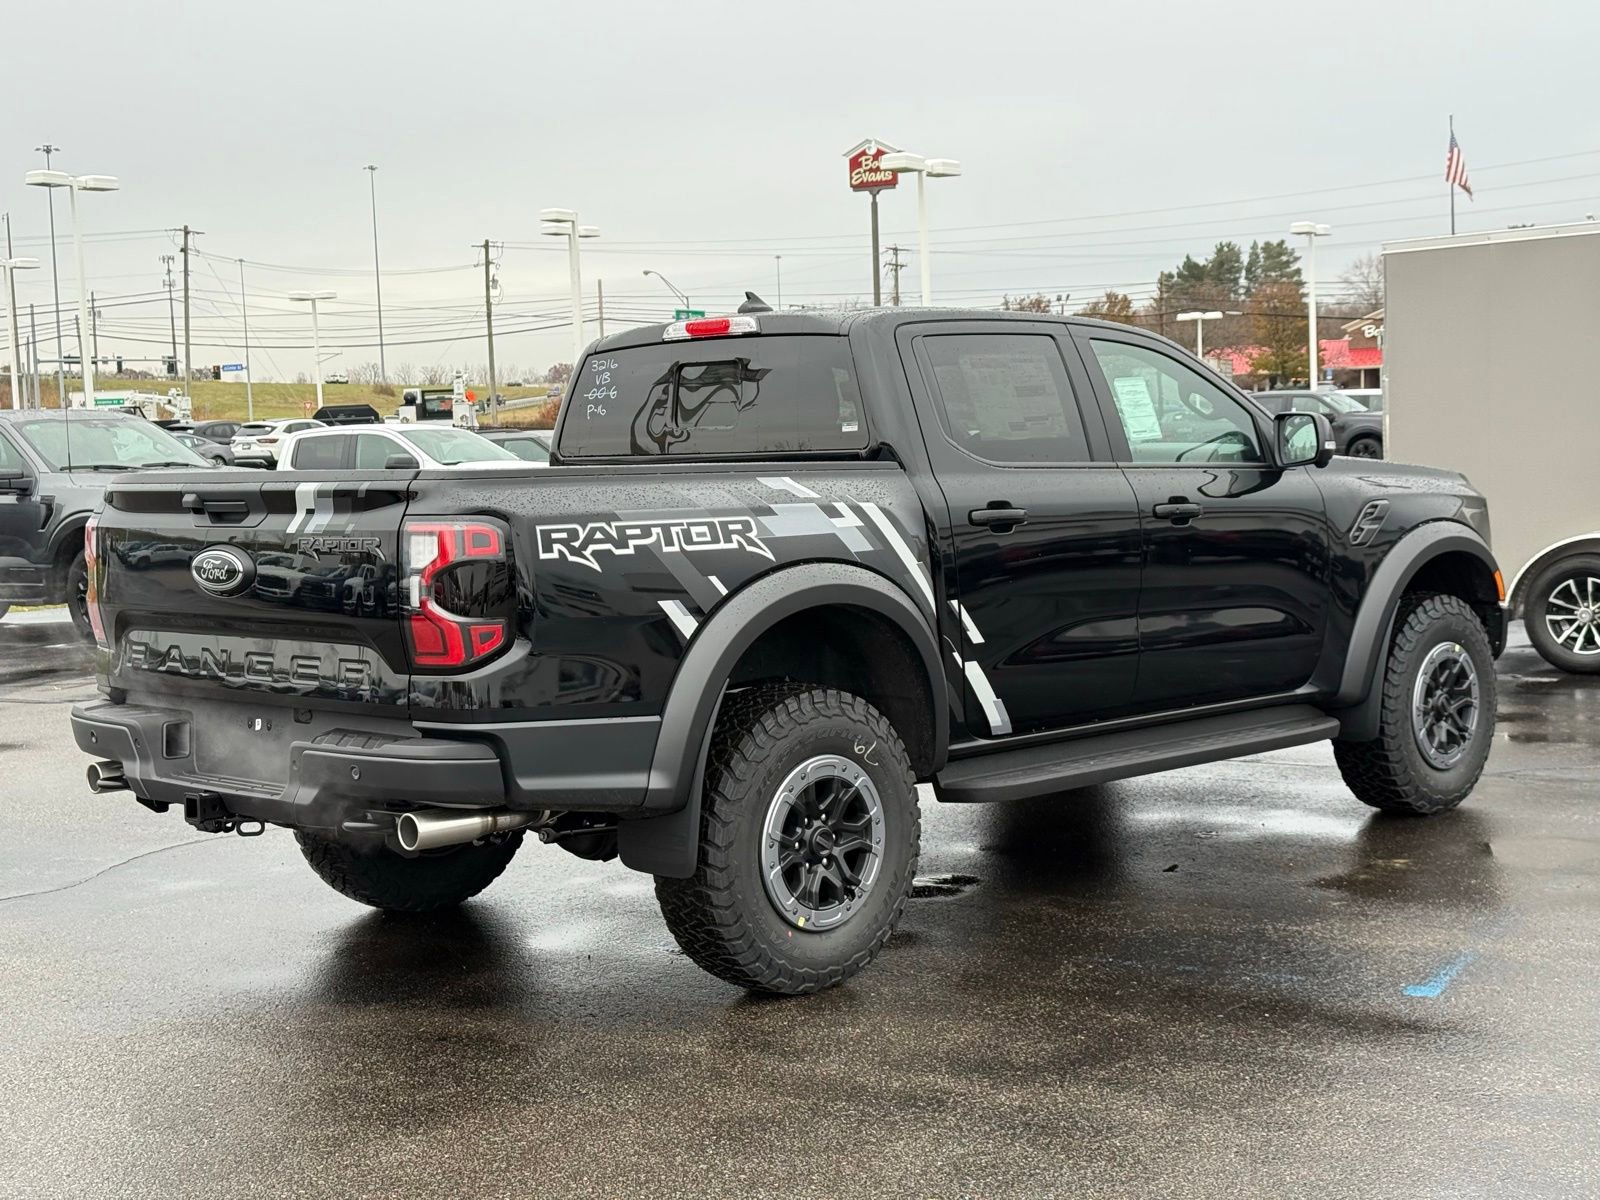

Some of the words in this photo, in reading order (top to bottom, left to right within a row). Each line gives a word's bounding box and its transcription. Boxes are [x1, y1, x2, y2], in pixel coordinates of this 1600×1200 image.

[851, 168, 893, 185] Evans
[591, 359, 618, 371] 3216
[596, 371, 611, 385] VB
[297, 536, 386, 562] RAPTOR
[535, 515, 777, 573] RAPTOR
[202, 558, 229, 582] Ford
[124, 640, 374, 691] RANGER
